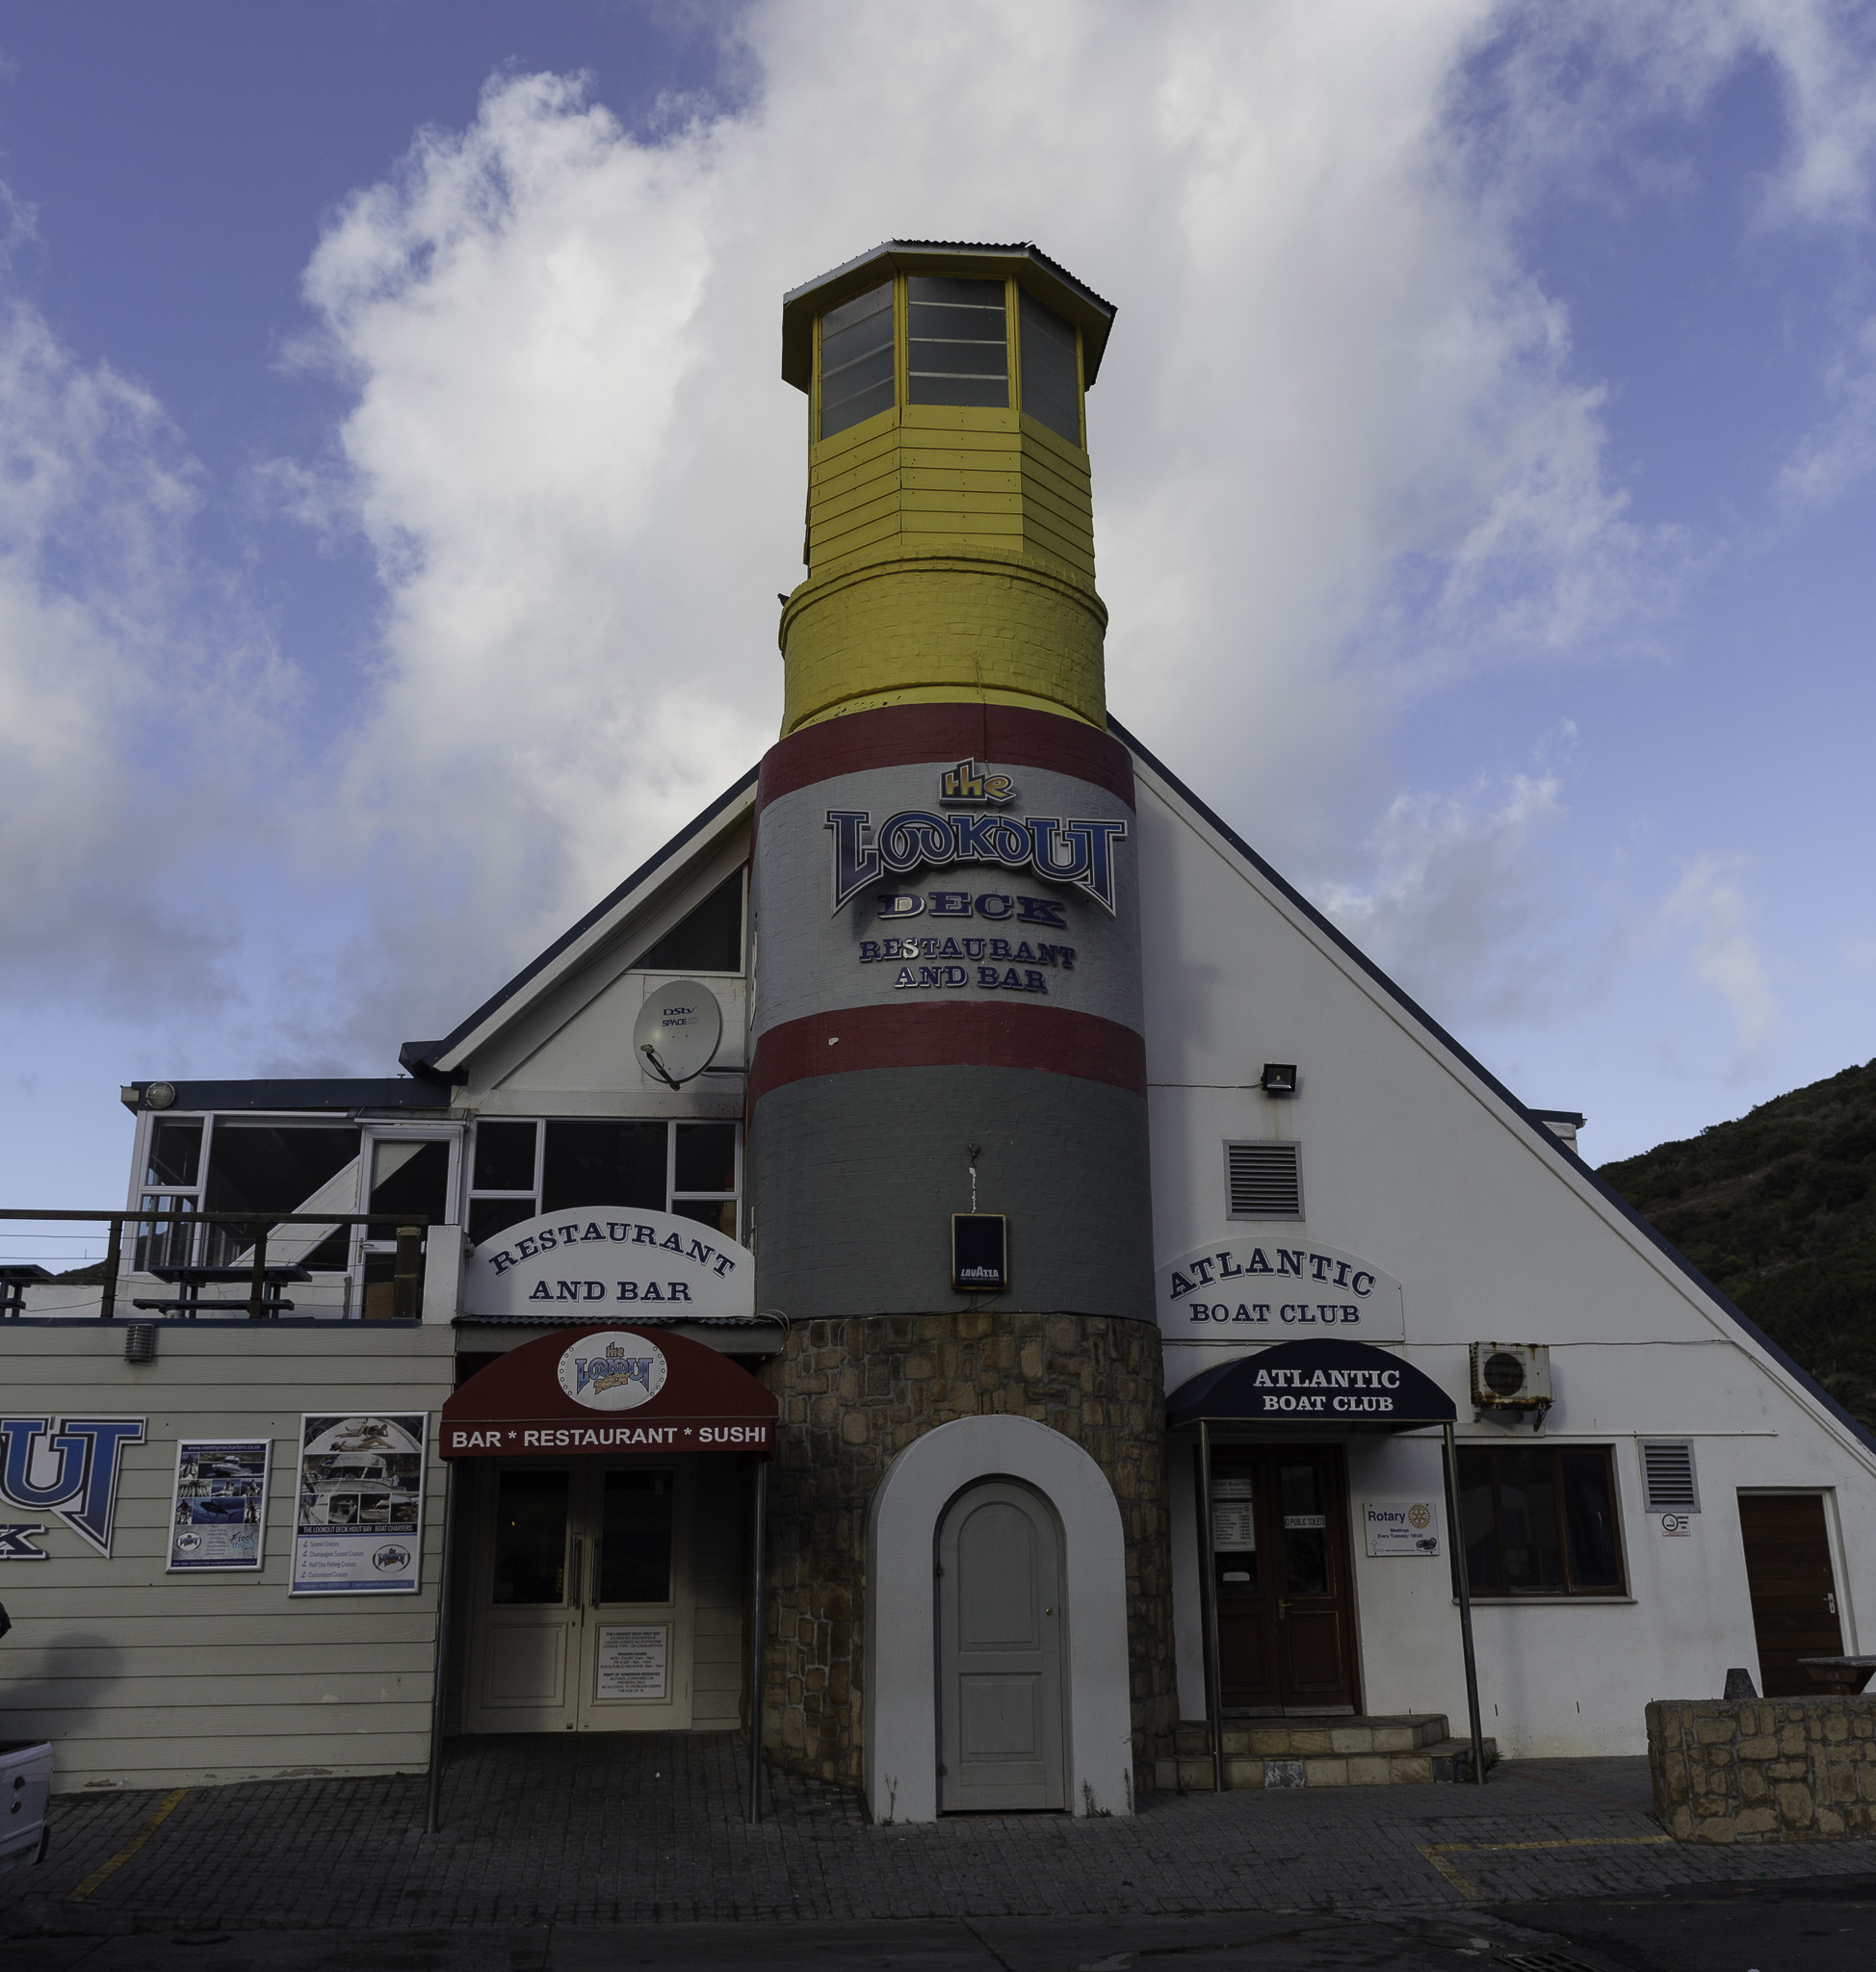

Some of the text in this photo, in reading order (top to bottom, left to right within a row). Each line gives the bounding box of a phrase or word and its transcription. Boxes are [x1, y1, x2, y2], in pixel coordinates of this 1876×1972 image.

[823, 809, 1128, 921] LOOKOUT
[877, 892, 1067, 928] DECK
[859, 937, 1077, 969] RESTAURANT
[894, 966, 1048, 993] AND BAR
[488, 1222, 735, 1277] RESTAURANT
[1170, 1248, 1375, 1300] ATLANTIC
[529, 1281, 693, 1303] AND BAR
[1190, 1303, 1361, 1324] BOAT CLUB
[575, 1357, 653, 1395] LOOKOUT
[1253, 1369, 1400, 1388] ATLANTIC
[1264, 1396, 1394, 1411] BOAT CLUB
[452, 1427, 767, 1447] BAR RESTAURANT SUSHI
[1290, 1518, 1307, 1526] PUBLIC
[1368, 1511, 1405, 1523] Rotary
